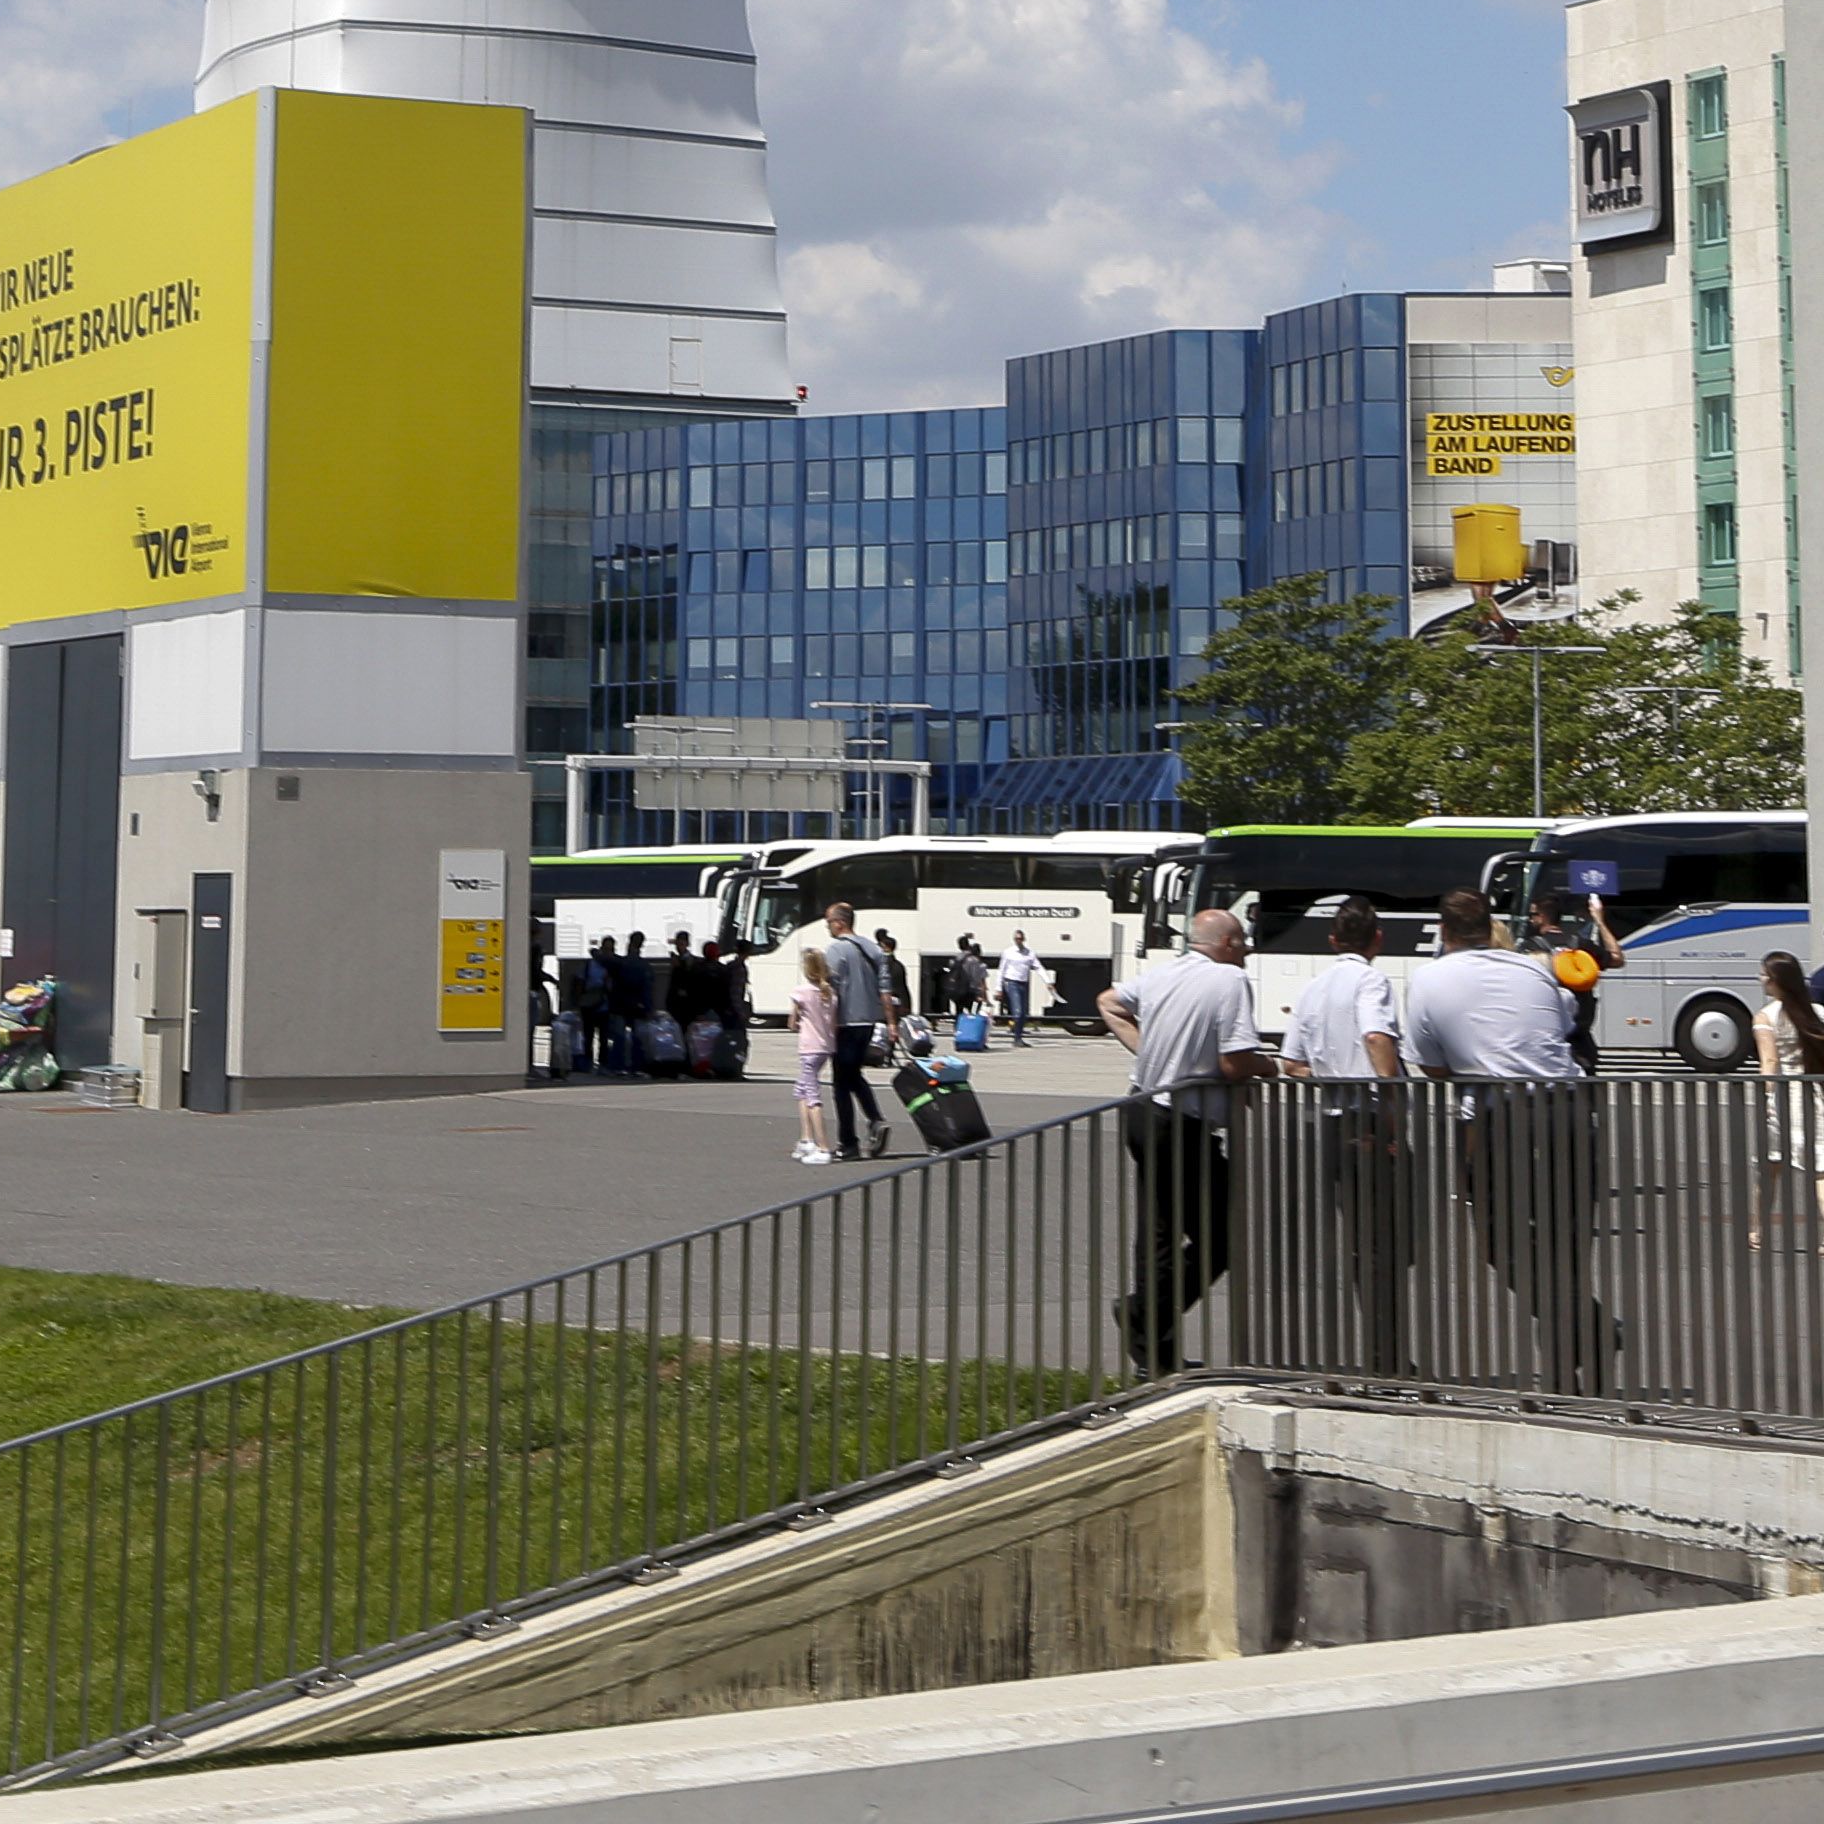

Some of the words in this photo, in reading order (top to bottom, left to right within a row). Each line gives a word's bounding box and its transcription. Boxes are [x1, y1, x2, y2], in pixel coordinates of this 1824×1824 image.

[24, 248, 74, 305] NEUE
[79, 277, 201, 356] BRAUCHEN:
[31, 417, 57, 485] 3.
[64, 387, 155, 477] PISTE!
[1432, 414, 1573, 432] ZUSTELLUNG
[1433, 435, 1467, 453] AM
[1434, 457, 1494, 474] BAND
